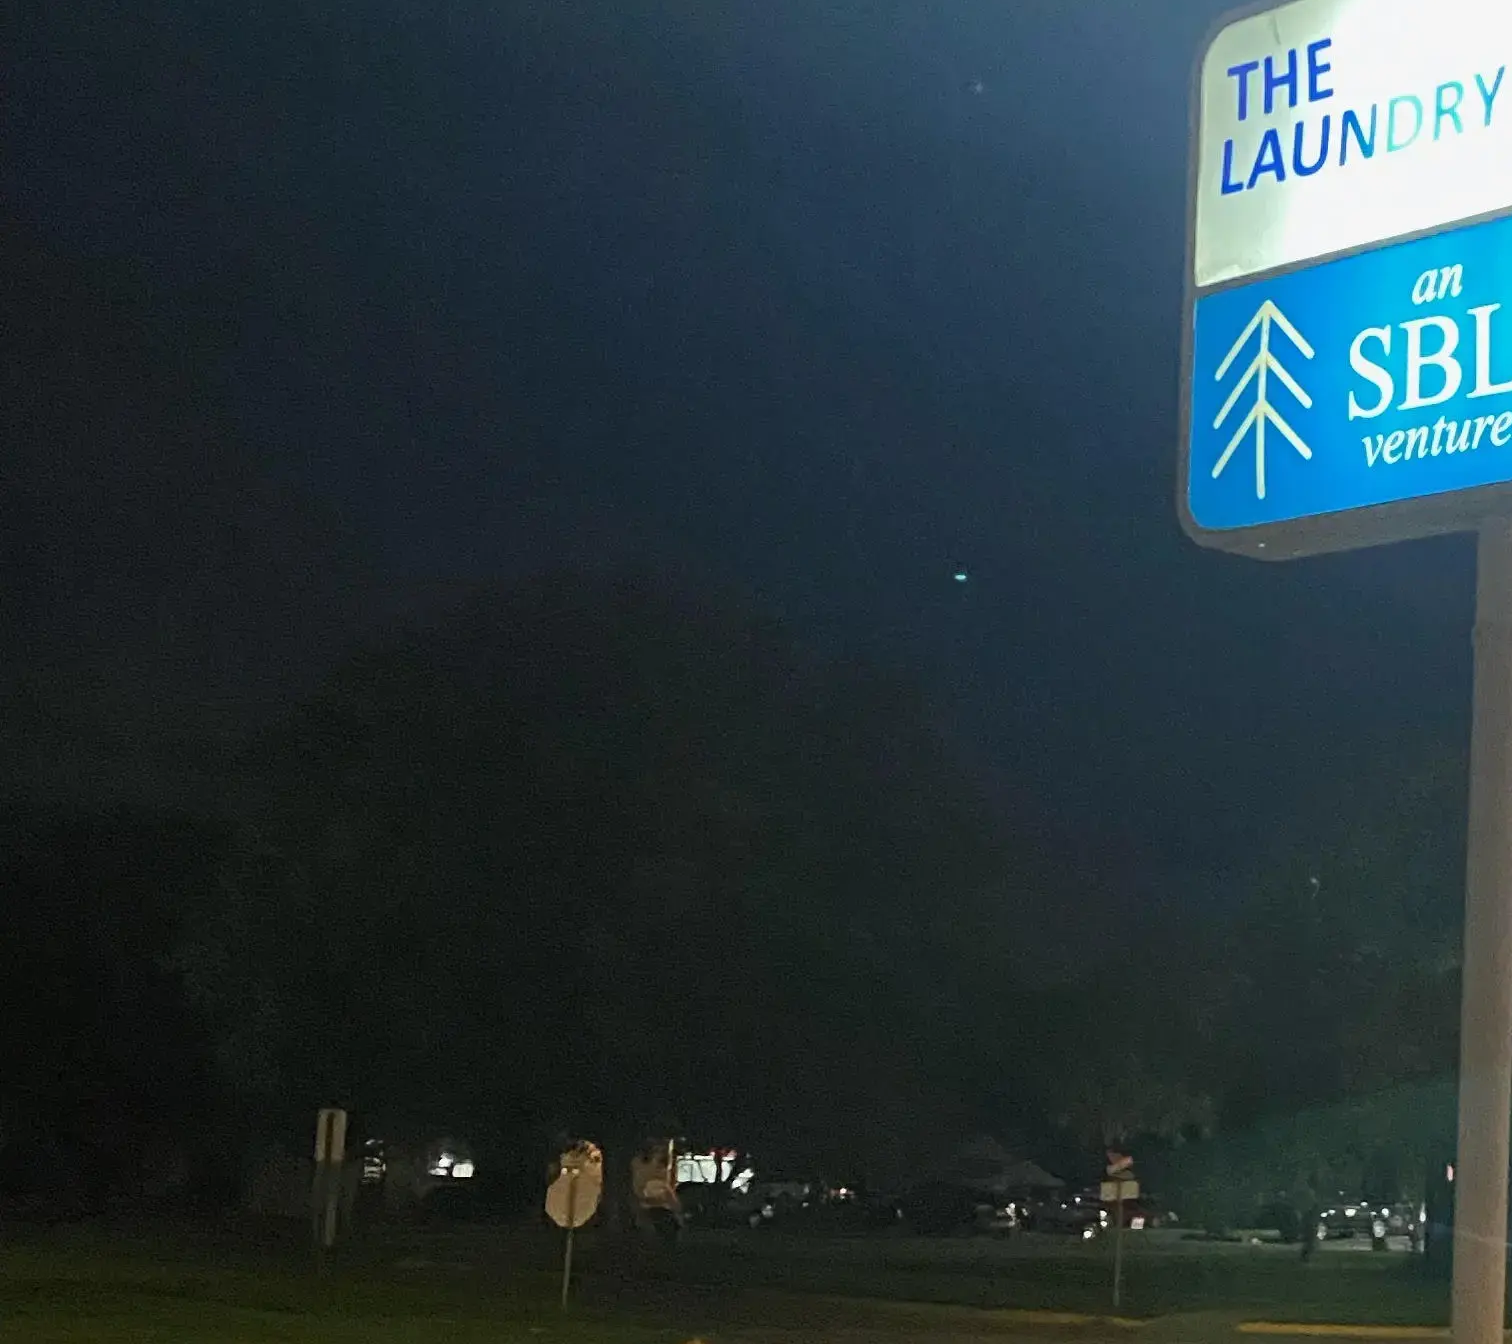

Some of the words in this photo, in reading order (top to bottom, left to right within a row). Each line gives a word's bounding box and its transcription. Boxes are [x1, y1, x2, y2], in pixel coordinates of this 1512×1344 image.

[1226, 38, 1334, 121] THE
[1220, 66, 1506, 196] LAUNDRY
[1411, 263, 1464, 306] an
